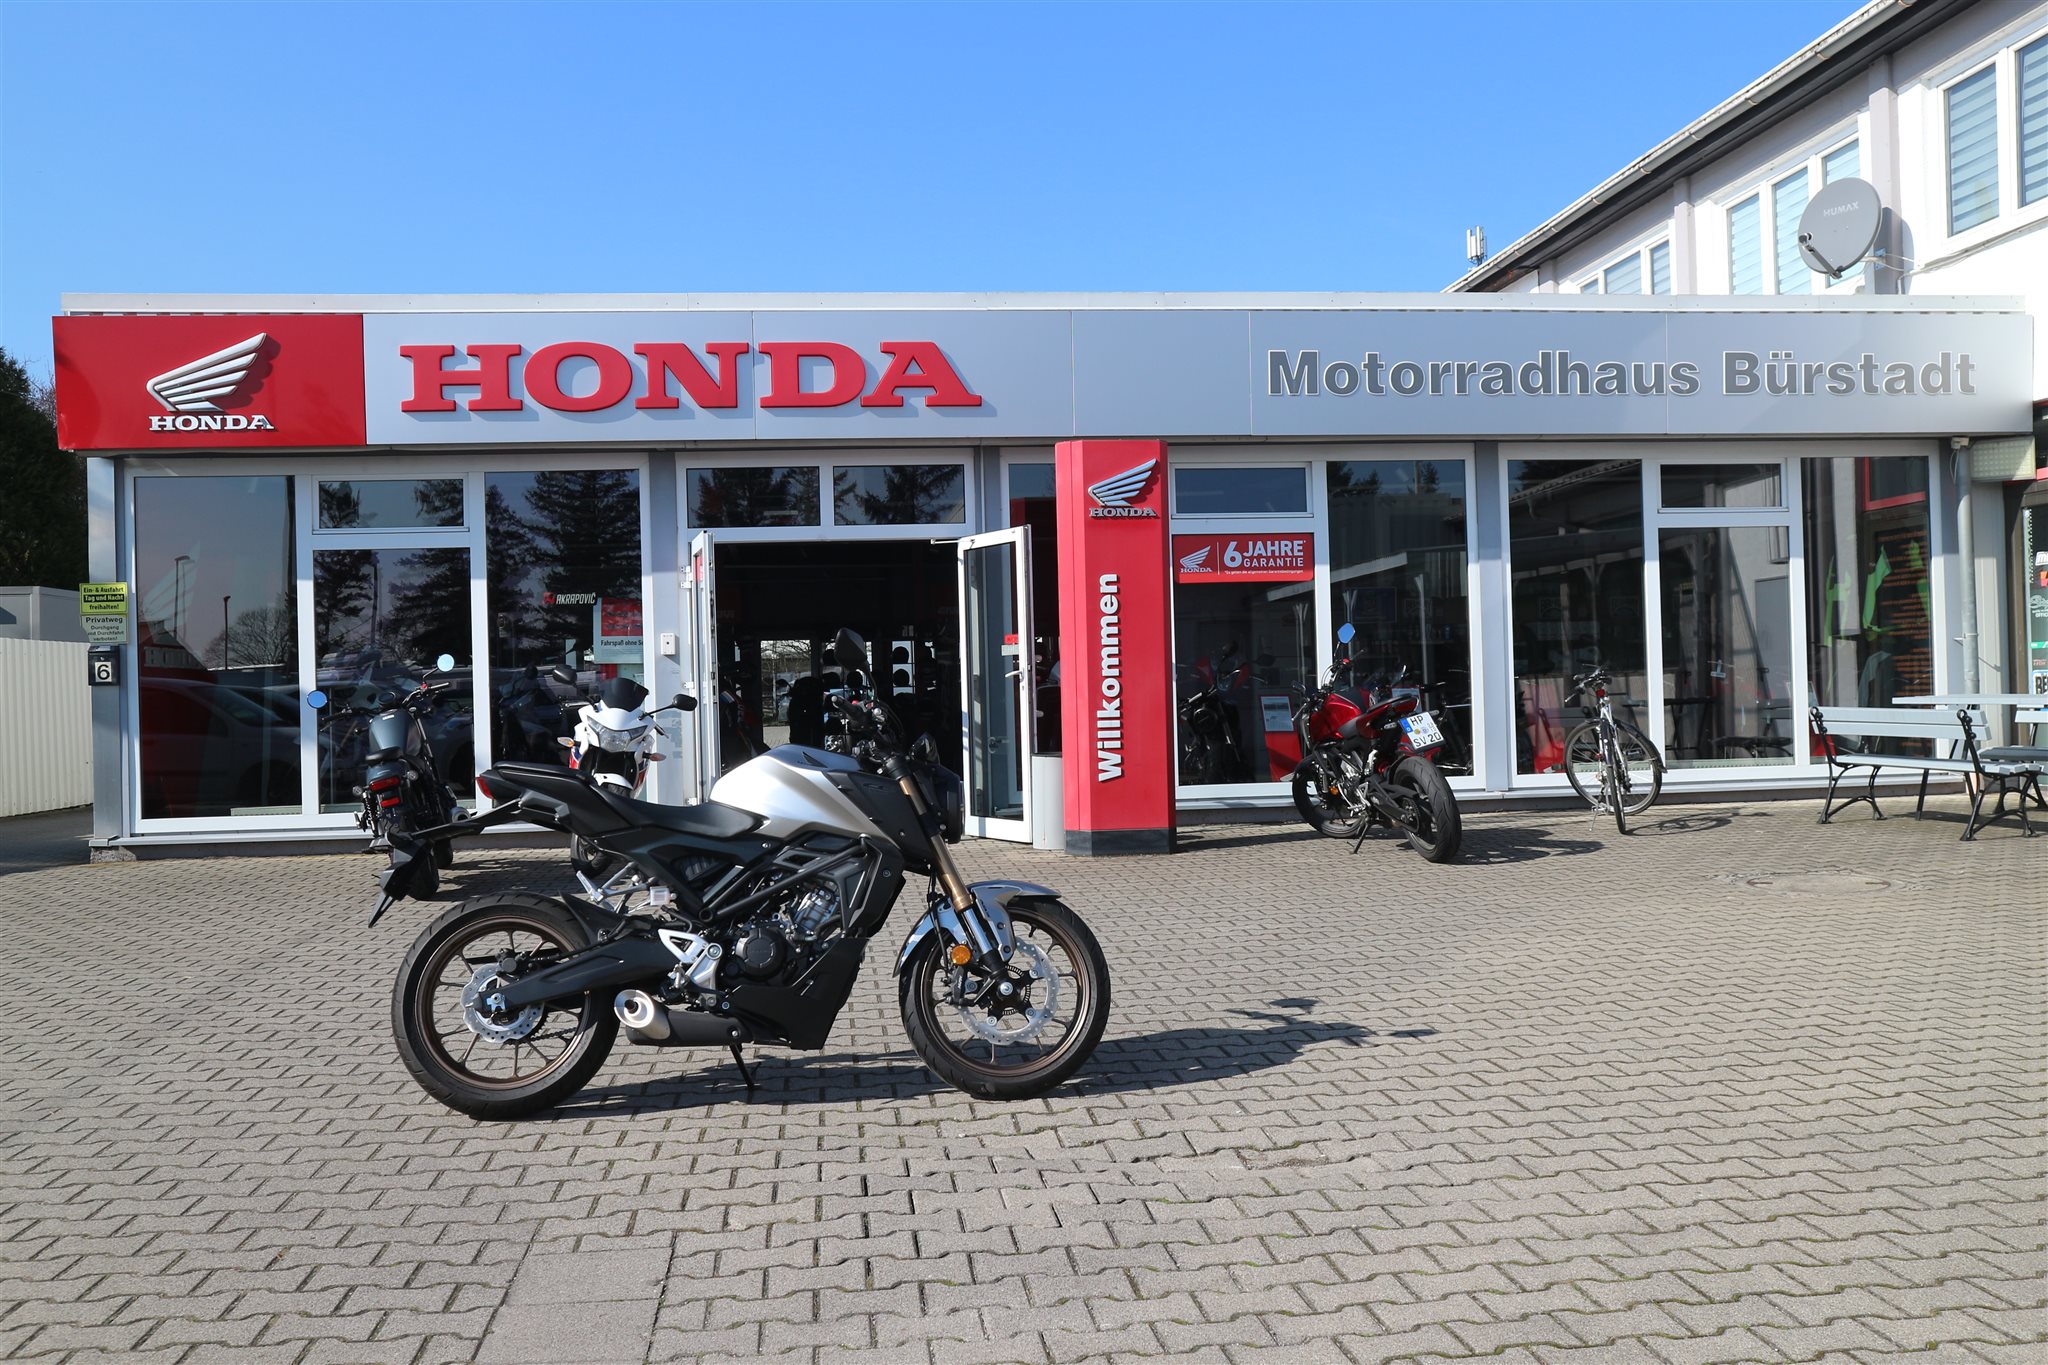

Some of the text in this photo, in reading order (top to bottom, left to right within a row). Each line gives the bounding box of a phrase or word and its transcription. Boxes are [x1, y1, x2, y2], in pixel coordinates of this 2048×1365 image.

[1823, 201, 1859, 217] HUMAX
[399, 341, 983, 412] HONDA
[1266, 349, 1978, 397] Motorradhaus Bürstadt
[149, 414, 275, 431] HONDA
[1088, 507, 1157, 518] HONDA
[1223, 541, 1243, 568] 6
[1243, 557, 1304, 568] GARANTIE
[85, 616, 123, 624] Privatweg
[600, 639, 624, 647] Fahrspaß
[97, 664, 110, 680] 6
[1096, 573, 1122, 782] Willkommen
[1410, 715, 1424, 727] HP
[1413, 731, 1442, 748] SV 20
